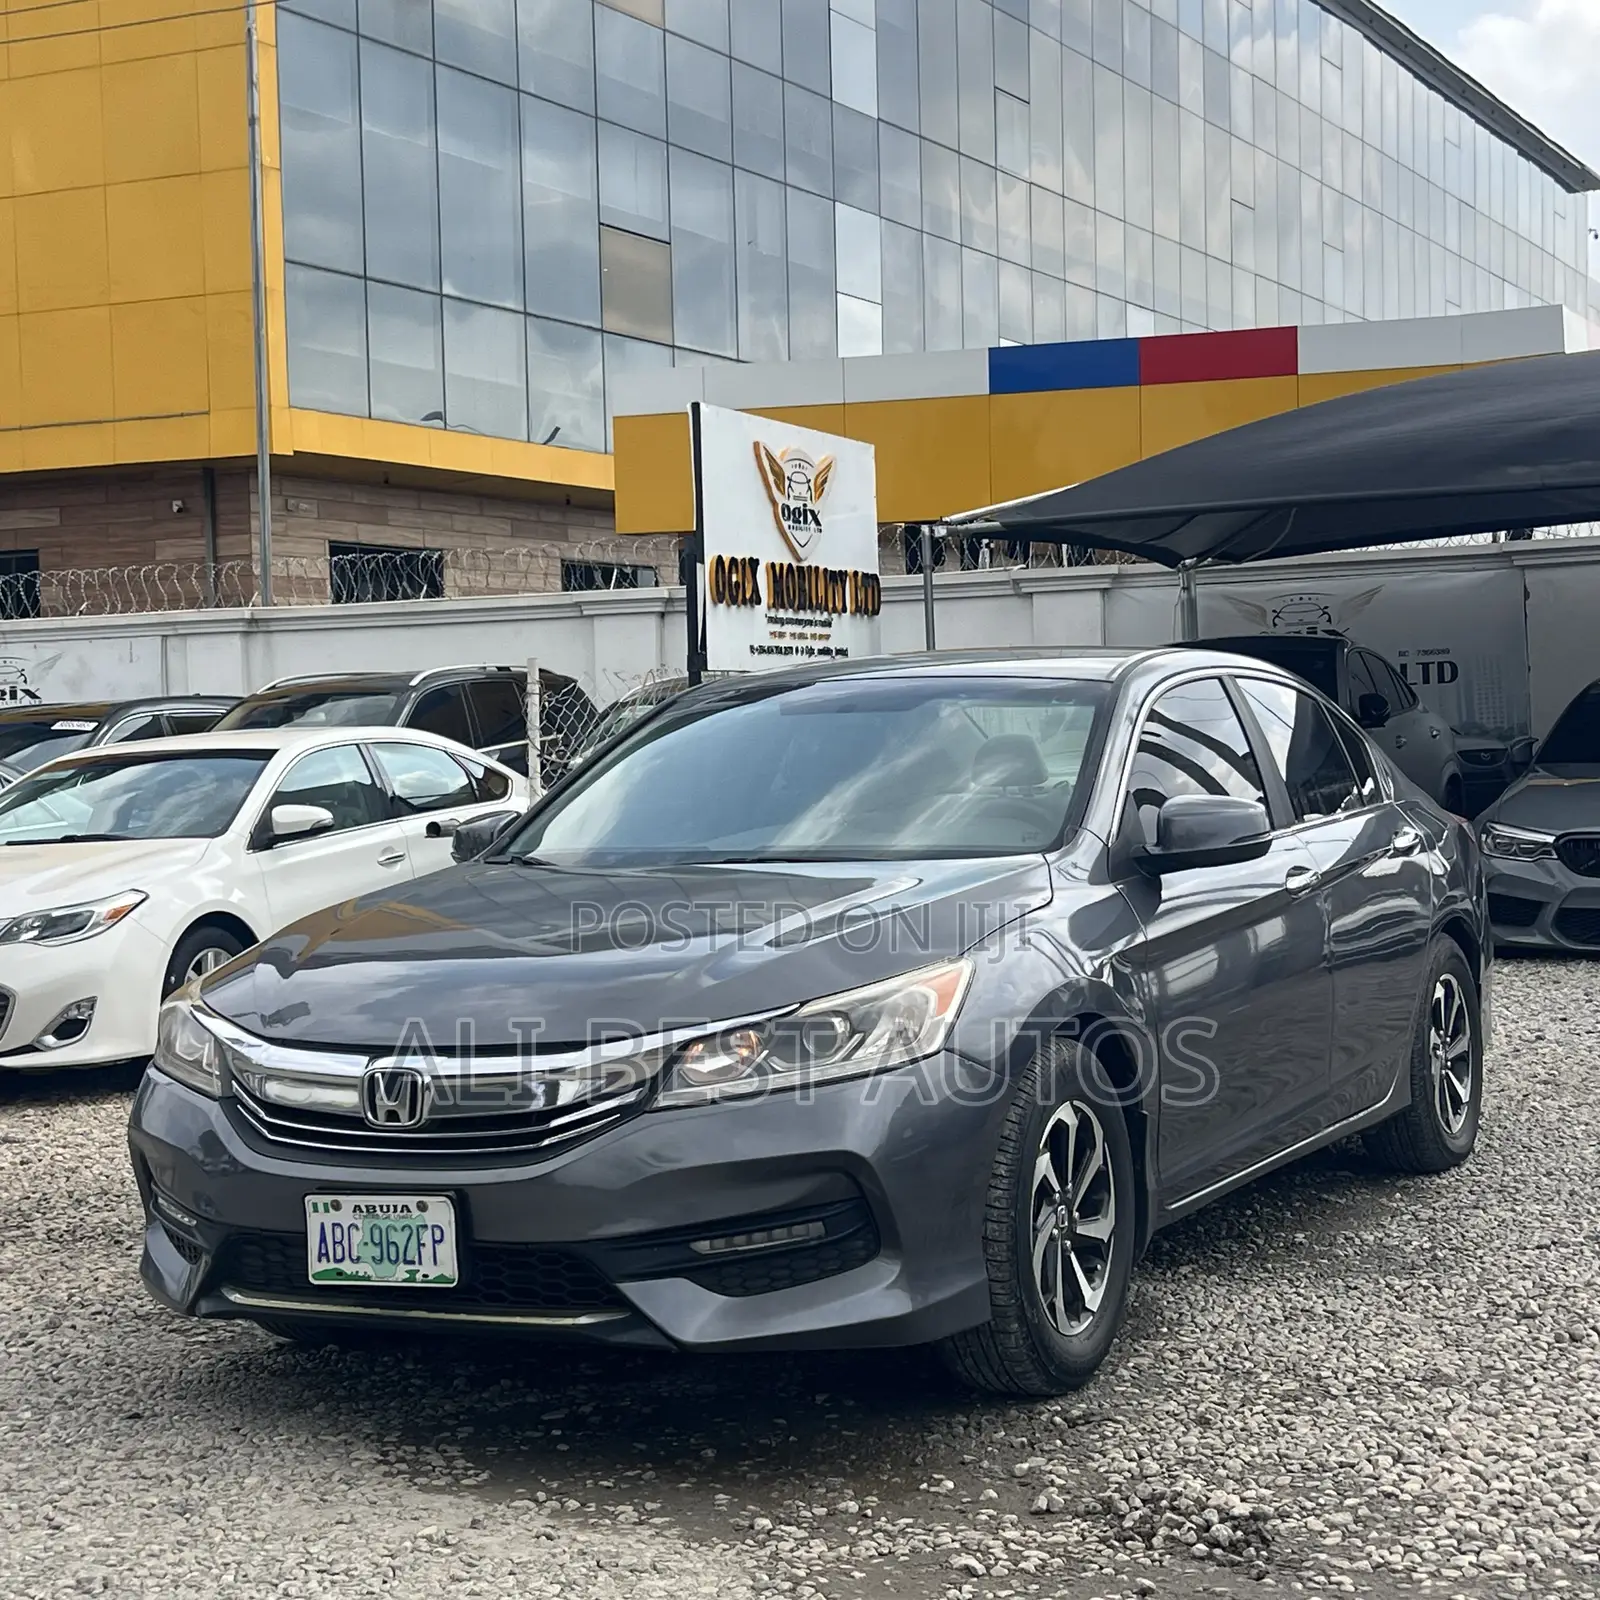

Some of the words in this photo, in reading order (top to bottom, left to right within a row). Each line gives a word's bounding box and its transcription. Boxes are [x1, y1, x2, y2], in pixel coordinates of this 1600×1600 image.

[709, 554, 762, 606] OGIX
[1399, 660, 1459, 686] LTD
[352, 1204, 412, 1214] ABUJA
